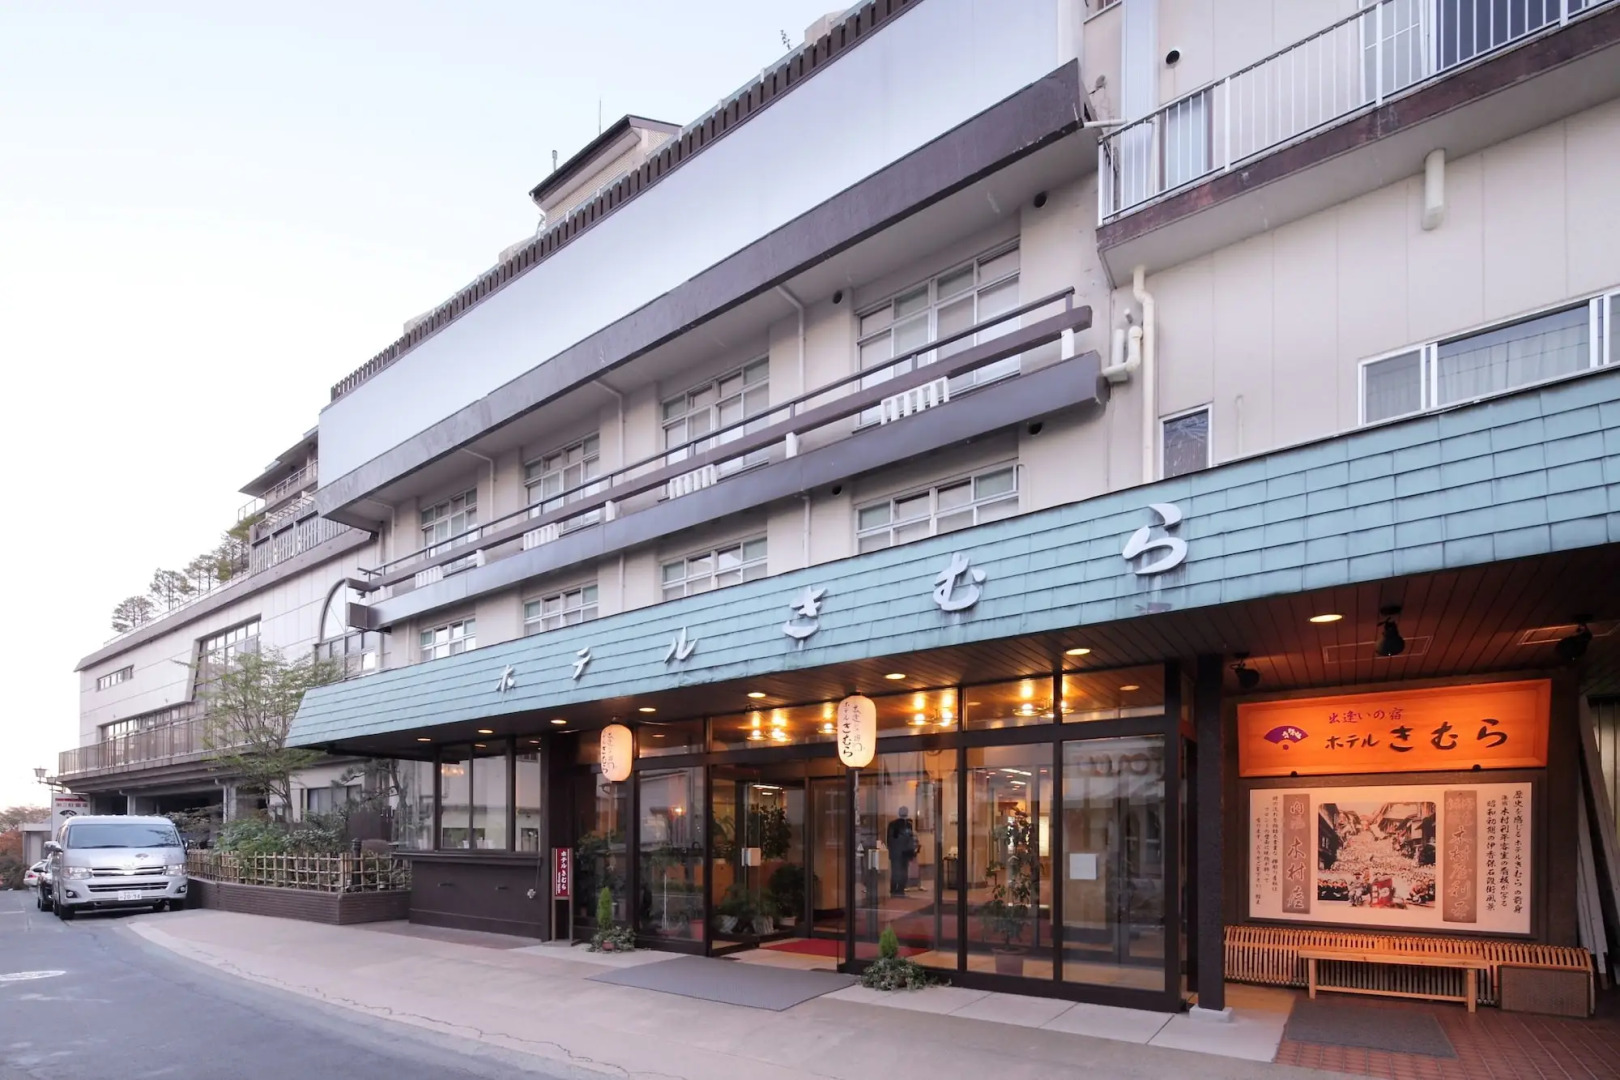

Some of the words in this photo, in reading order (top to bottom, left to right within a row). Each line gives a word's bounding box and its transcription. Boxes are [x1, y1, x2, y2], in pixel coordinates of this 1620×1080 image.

[496, 502, 1188, 692] ホテルきむら
[1328, 707, 1404, 724] 出逢いの宿
[1325, 719, 1508, 752] ホテルきむら
